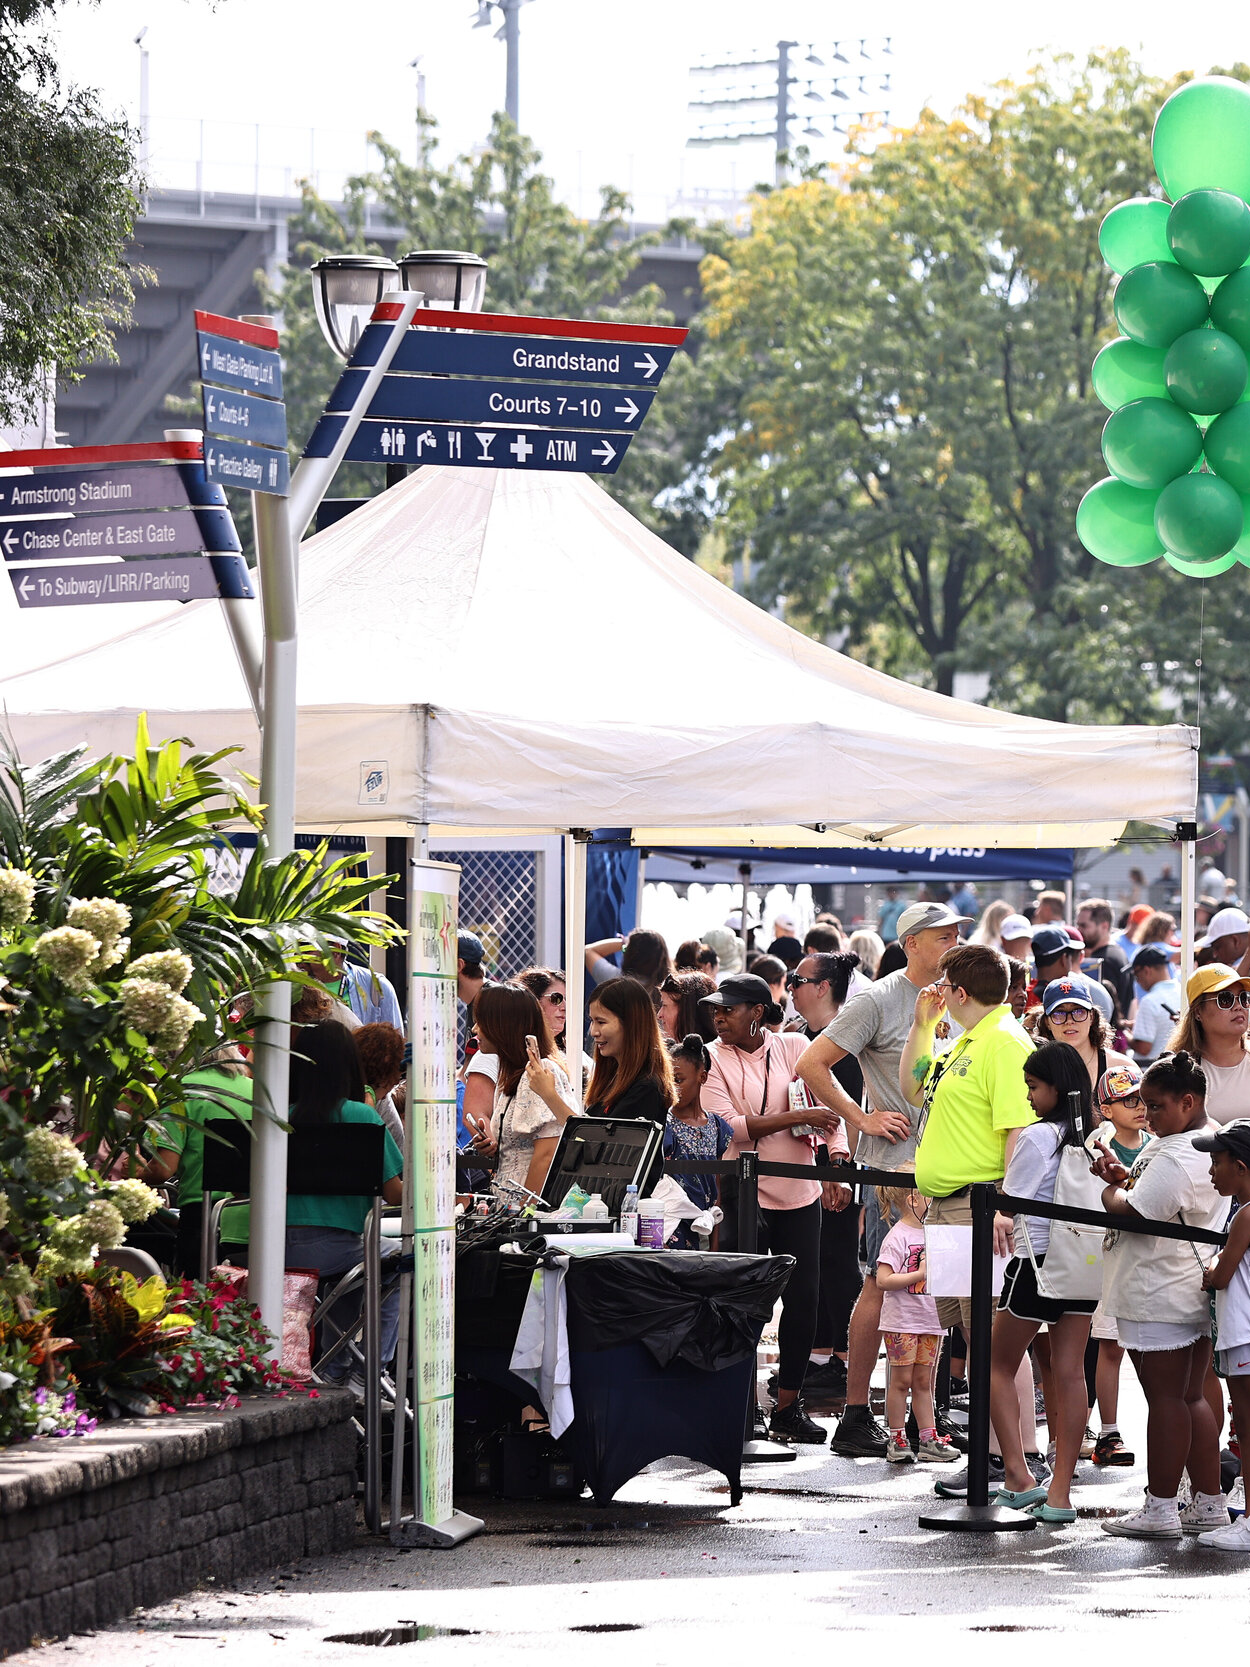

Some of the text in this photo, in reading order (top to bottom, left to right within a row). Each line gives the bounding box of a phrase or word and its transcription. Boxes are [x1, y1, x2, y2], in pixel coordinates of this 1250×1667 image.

[512, 347, 620, 373] Grandstand
[218, 401, 237, 425] Courts
[488, 392, 551, 415] Courts
[546, 439, 577, 462] ATM
[218, 453, 264, 484] Practice Gallery
[11, 480, 132, 506] Armstrong Stadium
[23, 524, 176, 550] Chase Center & East Gate
[37, 571, 190, 598] To Subway/LIRR/Parking
